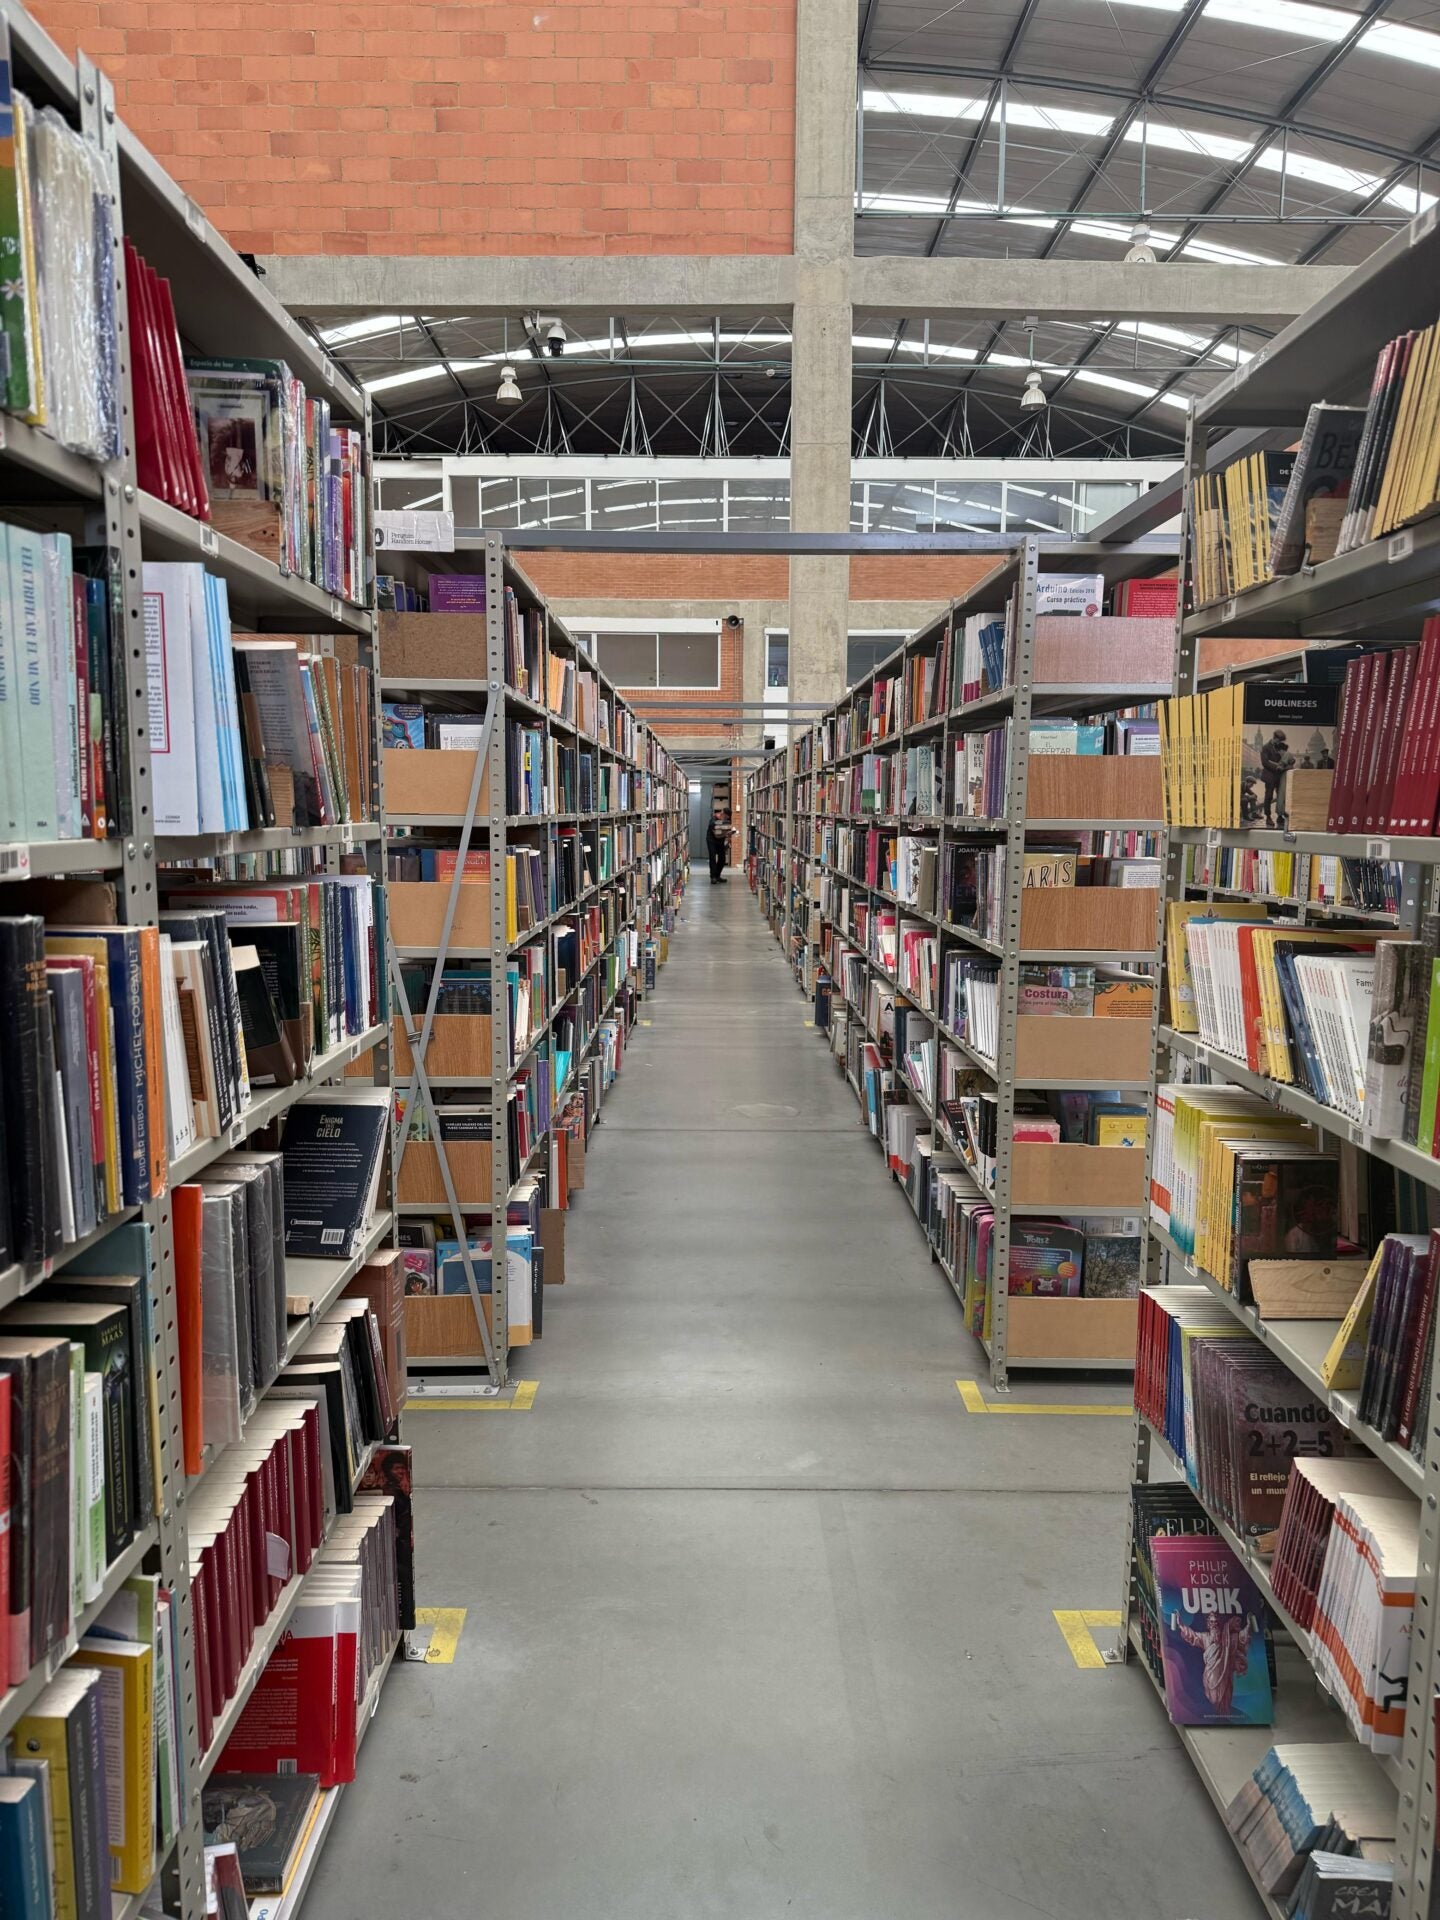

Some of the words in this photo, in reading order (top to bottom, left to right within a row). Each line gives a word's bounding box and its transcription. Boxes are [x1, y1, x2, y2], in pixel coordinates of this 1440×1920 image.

[20, 546, 41, 637] ELECTRIFICAR
[1037, 584, 1067, 594] Arduino
[1064, 596, 1086, 604] práctico
[27, 640, 40, 655] EL
[28, 655, 41, 706] MUNDO
[1357, 663, 1366, 691] GARCÍA
[1372, 660, 1380, 688] GARCÍA
[1390, 657, 1398, 685] GARCÍA
[1402, 654, 1412, 681] GARCÍA
[1346, 668, 1354, 697] GARCÍA
[1264, 698, 1318, 708] DUBLINESES
[1352, 692, 1362, 731] MÁRQUEZ
[1366, 689, 1376, 730] MÁRQUEZ
[1382, 686, 1394, 729] MÁRQUEZ
[1394, 682, 1406, 727] MÁRQUEZ
[128, 946, 143, 1027] FOUCAULT
[1025, 988, 1068, 999] Costura
[92, 1050, 100, 1072] guerra
[132, 1030, 146, 1087] MICHEL
[135, 1094, 146, 1138] ERIBON
[320, 1114, 344, 1124] ENIGMA
[316, 1128, 341, 1138] CIELO
[136, 1139, 148, 1178] DIDIER
[1244, 1403, 1330, 1423] Cuando
[111, 1403, 122, 1460] HEREDERA
[1248, 1430, 1334, 1457] 2+2=5
[114, 1462, 122, 1475] DE
[1250, 1472, 1258, 1480] El
[1259, 1472, 1286, 1482] reflejo
[115, 1476, 124, 1512] FUEGO
[1166, 1518, 1184, 1536] El
[1189, 1560, 1228, 1572] PHILIP
[1182, 1588, 1242, 1614] UBIK
[138, 1722, 149, 1778] MÍSTICA
[139, 1782, 150, 1839] CÁBALA
[142, 1843, 151, 1860] LA
[1334, 1886, 1379, 1897] CREA
